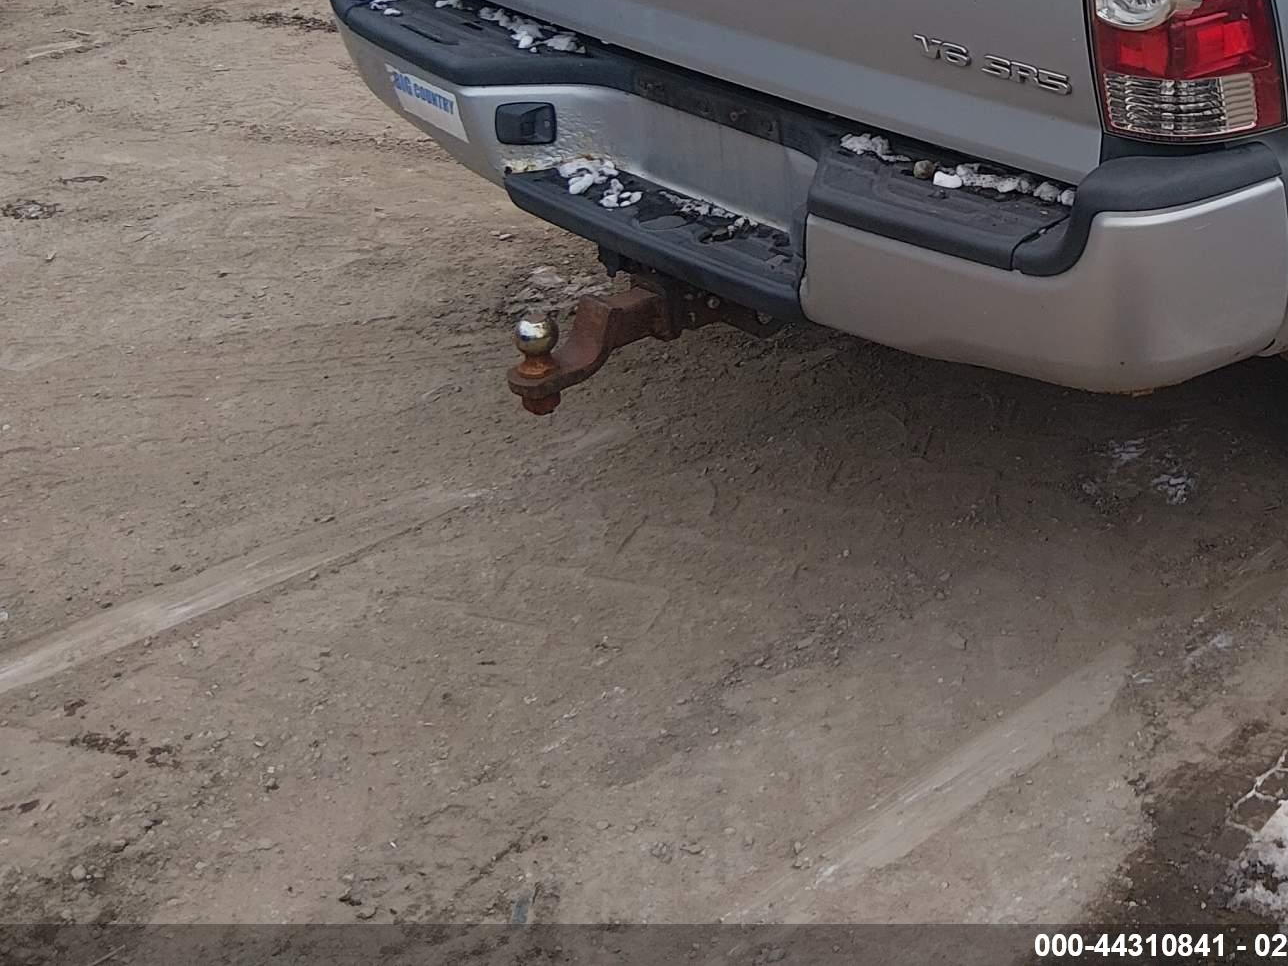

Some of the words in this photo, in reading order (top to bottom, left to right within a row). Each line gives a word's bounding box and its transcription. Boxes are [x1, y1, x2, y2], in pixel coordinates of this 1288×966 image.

[393, 70, 414, 97] BIG
[413, 82, 454, 115] COUNTRY
[913, 34, 972, 68] V6
[981, 54, 1072, 97] SR5
